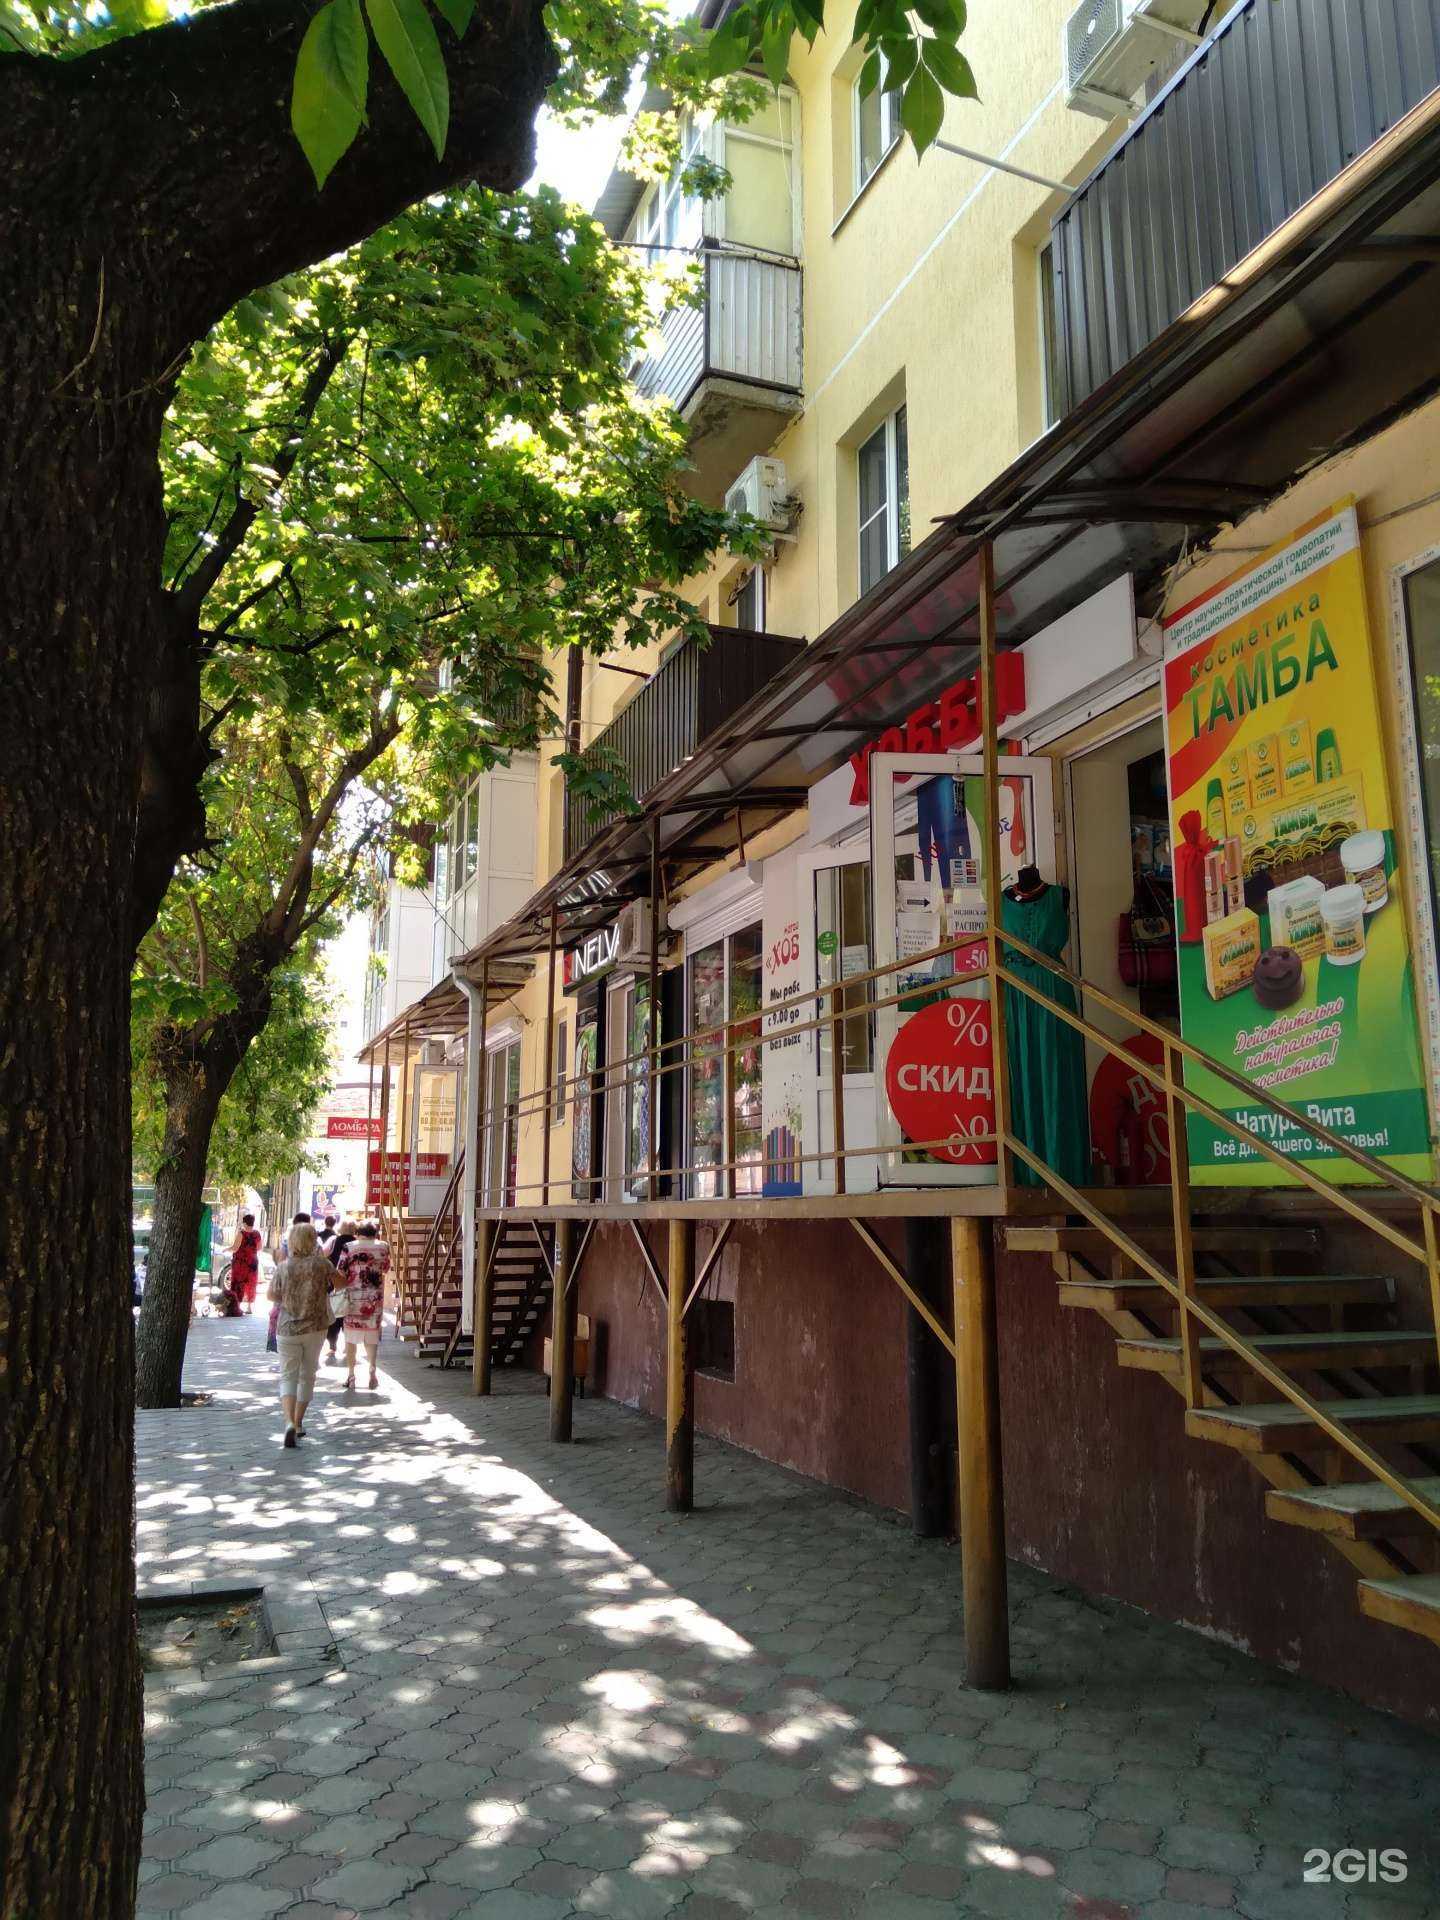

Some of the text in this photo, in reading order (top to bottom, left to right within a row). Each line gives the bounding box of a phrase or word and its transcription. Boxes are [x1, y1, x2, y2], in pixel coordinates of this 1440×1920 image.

[1170, 620, 1194, 641] Центр
[1194, 558, 1284, 626] научно-практической
[1285, 522, 1342, 568] гомеопатии
[1177, 543, 1335, 649] и традиционной медицины «Адонис»
[1190, 592, 1321, 681] косметика
[1182, 617, 1339, 739] ТАМБА
[955, 921, 988, 932] РАСПРО
[772, 1008, 789, 1025] 9.00
[1233, 996, 1345, 1055] Действительно
[1243, 1020, 1342, 1072] натуральная
[897, 1063, 992, 1101] СКИД
[1213, 1140, 1236, 1157] Всё
[1269, 1139, 1313, 1154] ашего
